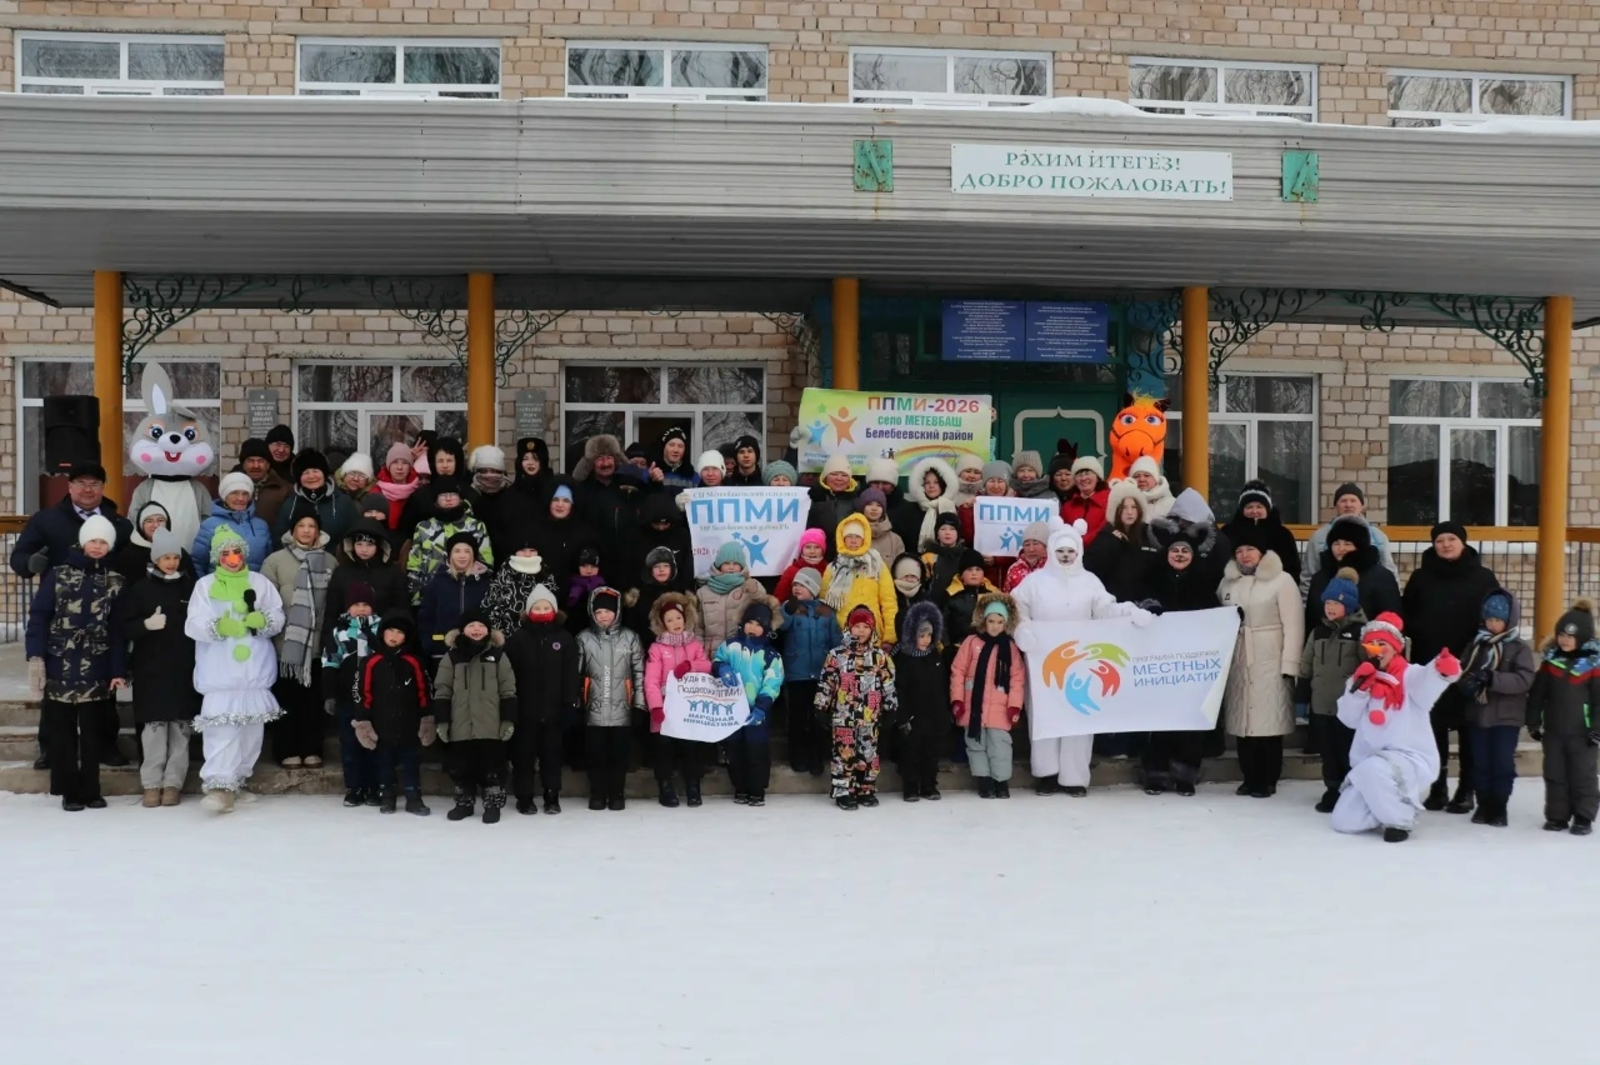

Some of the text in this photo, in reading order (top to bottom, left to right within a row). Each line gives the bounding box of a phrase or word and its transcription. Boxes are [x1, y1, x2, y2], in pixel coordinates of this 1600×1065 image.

[960, 173, 1227, 195] ДОБРО ПОЖАЛОВАТЬ!
[867, 396, 980, 413] ППМИ-2026
[877, 415, 962, 427] село МЕТЕВБАШ
[865, 427, 973, 441] Белебеевский район
[690, 498, 800, 525] ППМИ
[979, 504, 1050, 523] ППМИ
[1175, 650, 1220, 660] ПОДДЕРЖКИ
[1132, 658, 1222, 676] МЕСТНЫХ
[683, 717, 740, 727] ИНИЦИАТИВА
[688, 713, 735, 722] НАРОДНАЯ
